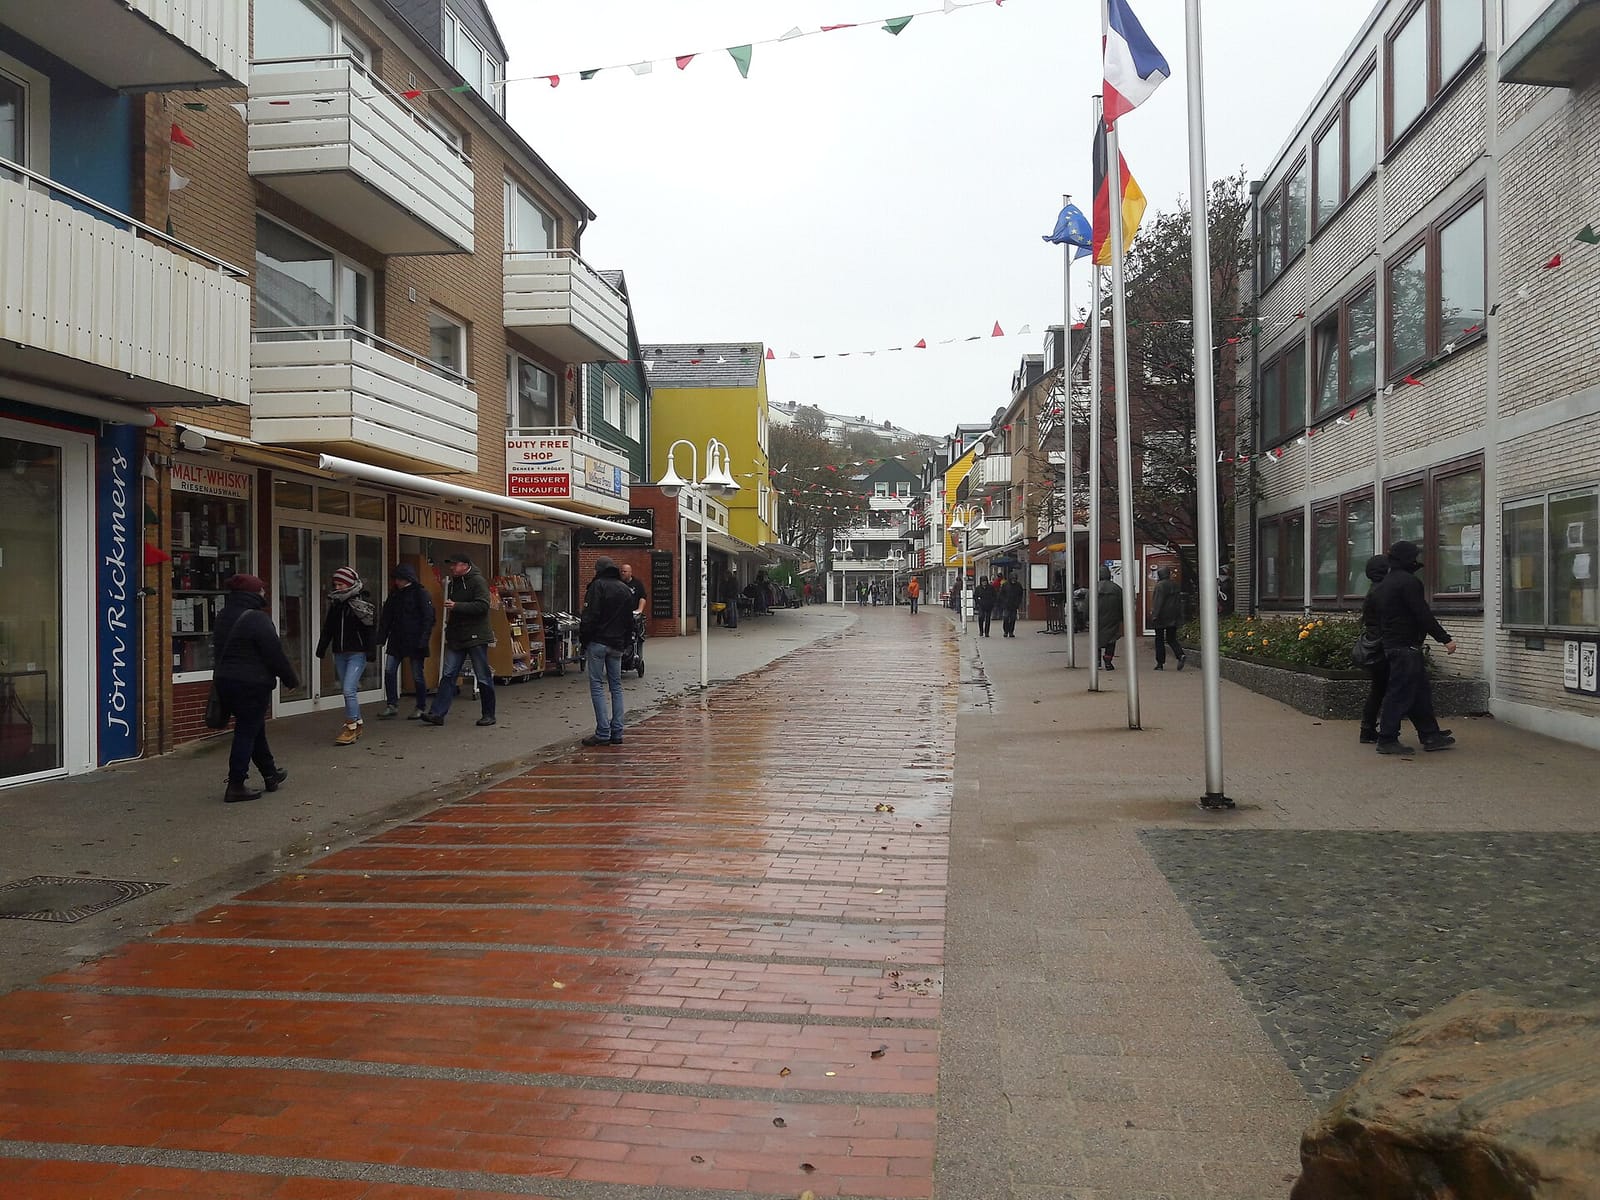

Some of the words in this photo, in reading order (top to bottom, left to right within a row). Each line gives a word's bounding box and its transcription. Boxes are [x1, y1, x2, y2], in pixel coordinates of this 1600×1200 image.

[507, 440, 536, 449] DUTY
[540, 440, 569, 449] FREE
[523, 452, 553, 460] SHOP
[172, 463, 248, 490] MALT-WHISKY
[511, 475, 567, 484] PREISWERT
[181, 481, 241, 498] RIESENAUSWAHL
[511, 485, 567, 494] EINKAUFEN
[399, 503, 430, 528] DUTY
[435, 510, 461, 531] FREE
[465, 515, 491, 536] SHOP
[105, 446, 129, 633] Rickmers
[107, 635, 130, 737] Jörn
